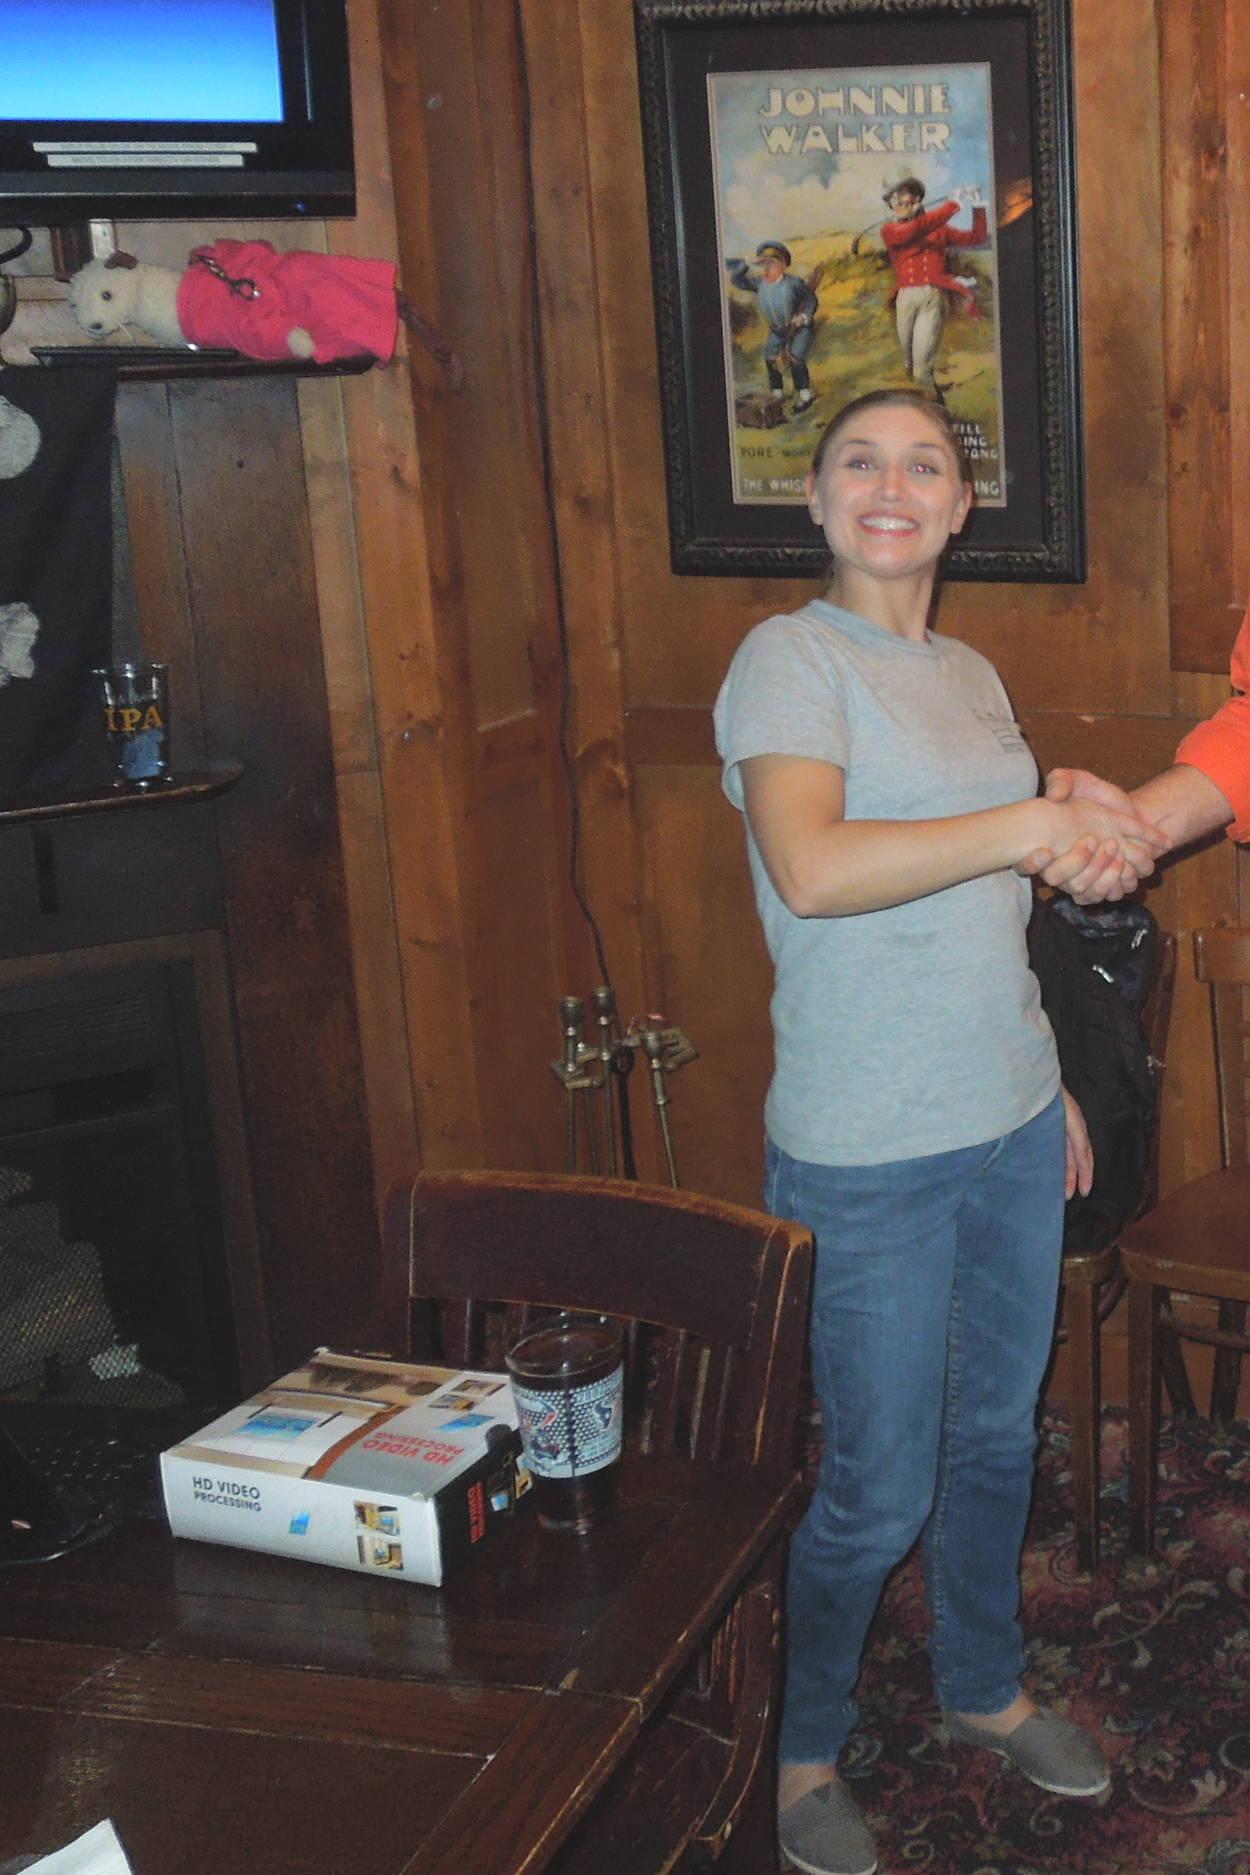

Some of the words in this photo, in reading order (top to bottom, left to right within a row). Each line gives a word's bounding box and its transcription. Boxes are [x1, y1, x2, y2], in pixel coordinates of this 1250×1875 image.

[758, 83, 951, 117] JOHNNIE
[759, 121, 951, 153] WALKER
[103, 705, 164, 732] IPA
[192, 1476, 214, 1491] HD
[216, 1480, 261, 1500] VIDEO
[194, 1490, 262, 1512] PROCESSING
